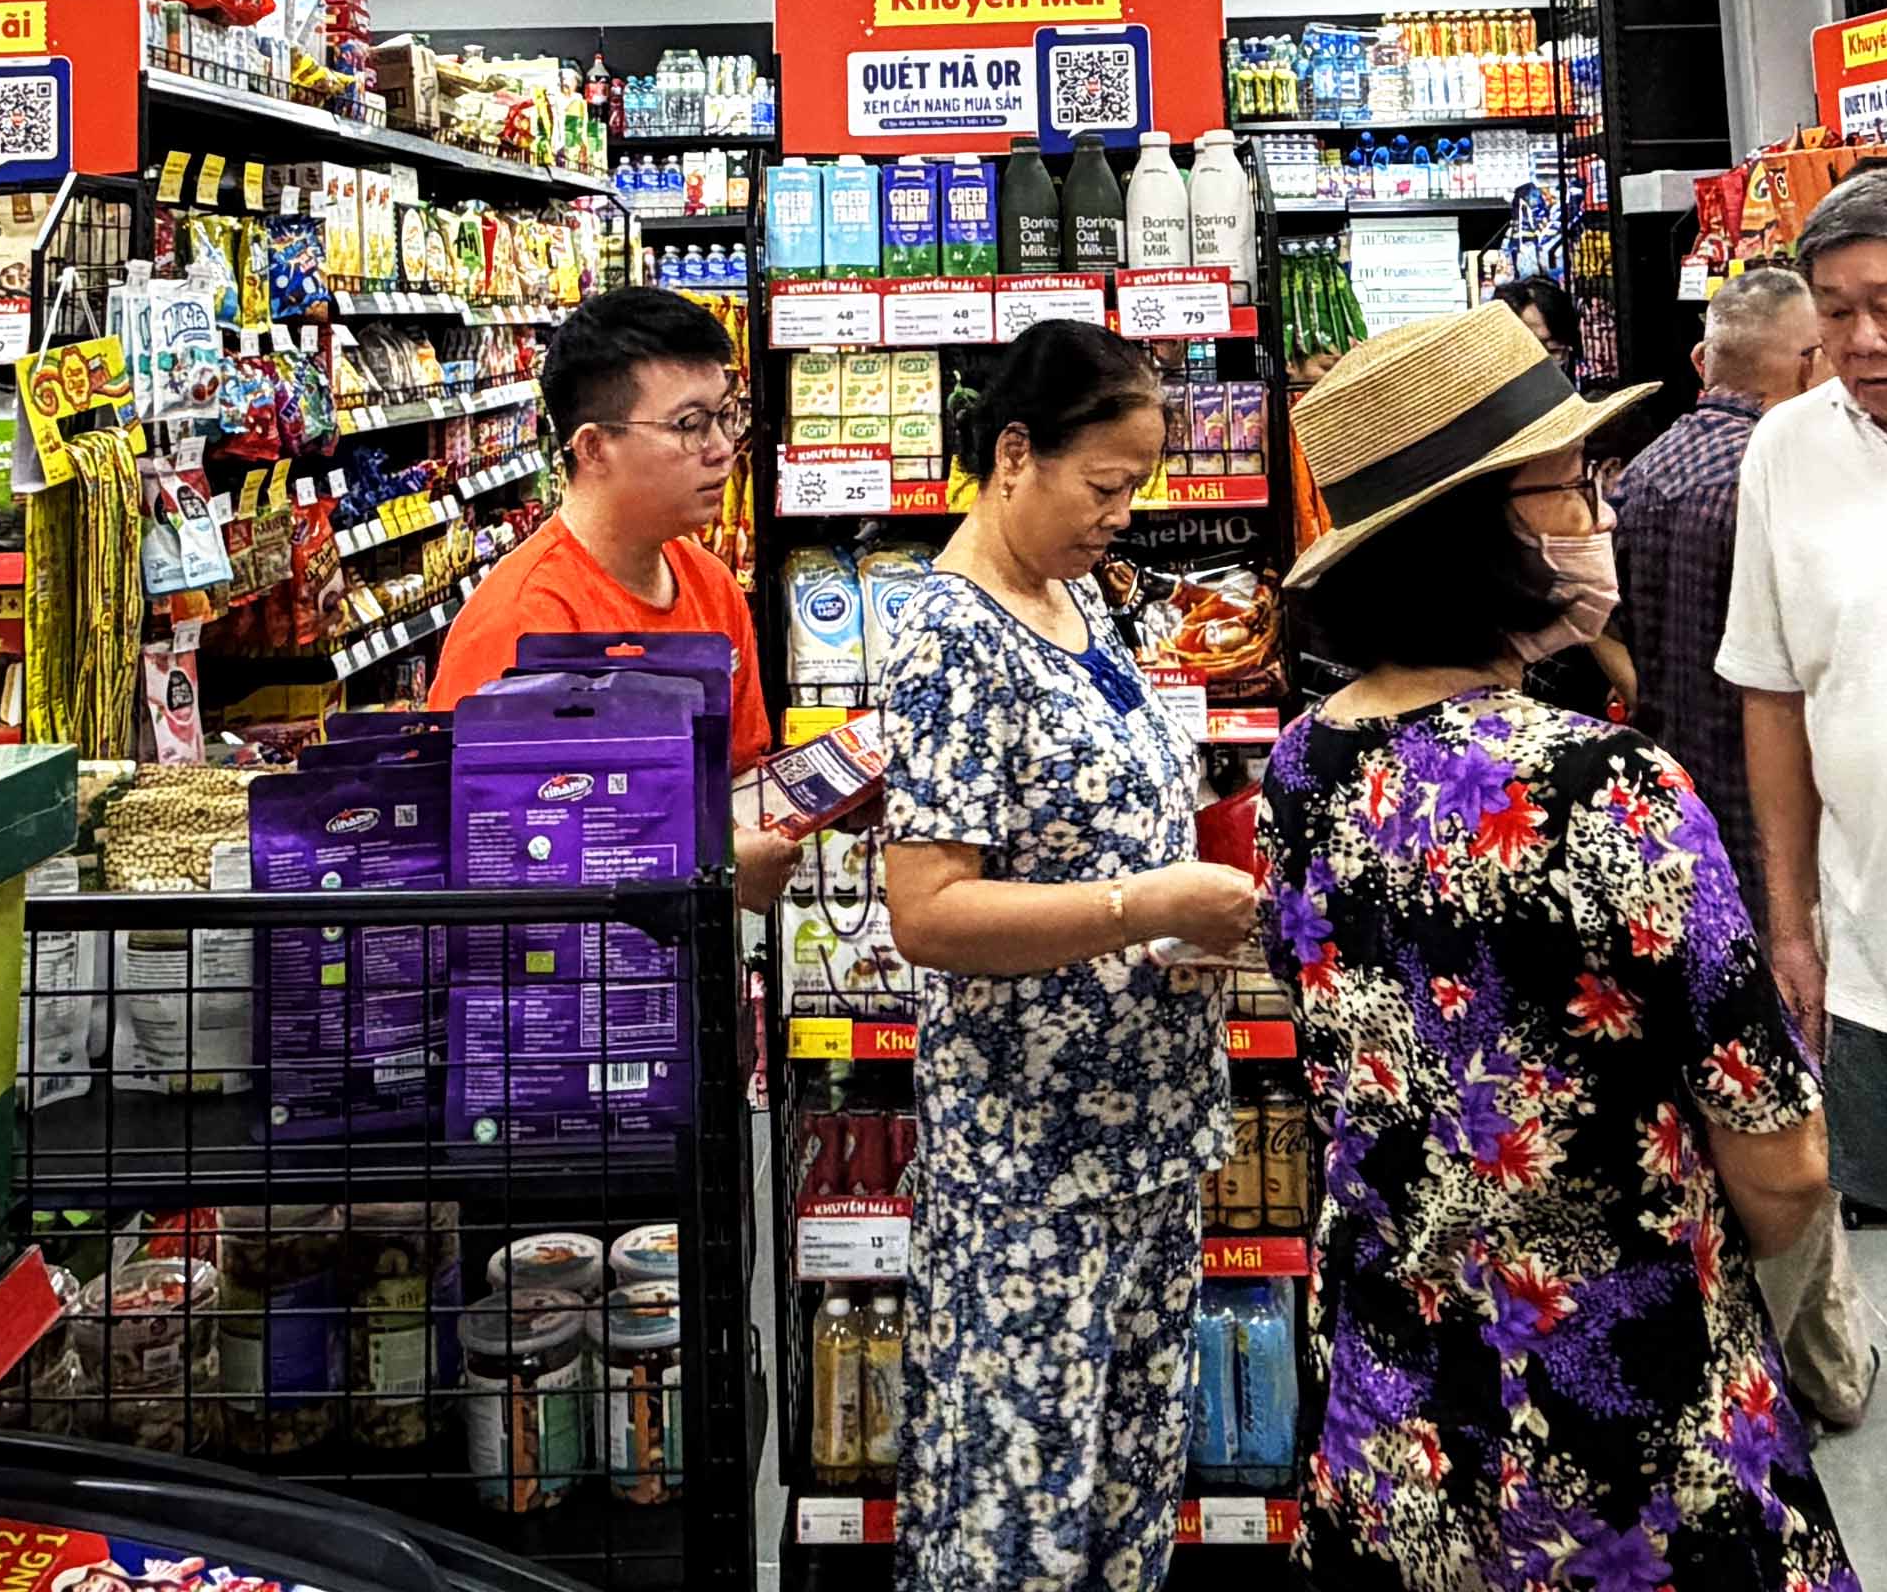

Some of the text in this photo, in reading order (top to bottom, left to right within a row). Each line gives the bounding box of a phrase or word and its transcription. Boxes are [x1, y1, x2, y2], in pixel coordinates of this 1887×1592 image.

[862, 55, 1021, 93] QUÉT MÃ QR
[863, 100, 889, 115] XEM
[925, 99, 961, 114] NANG
[965, 97, 991, 111] MUA
[889, 189, 930, 206] GREEN
[948, 187, 988, 204] GREEN
[891, 205, 928, 223] FARM
[951, 203, 987, 221] FARM
[1020, 216, 1059, 233] Boring
[1076, 216, 1116, 233] Boring
[1142, 216, 1185, 232] Boring
[1194, 214, 1236, 228] Boring
[1020, 231, 1045, 243] Oat
[1076, 230, 1100, 243] Oat
[1143, 231, 1168, 243] Oat
[1195, 229, 1216, 240] Oat
[1020, 244, 1048, 257] Milk
[1076, 244, 1103, 257] Milk
[1143, 244, 1172, 256] Milk
[1196, 242, 1219, 255] Milk
[837, 311, 854, 320] 48
[953, 309, 969, 319] 48
[1182, 311, 1205, 324] 79
[837, 328, 854, 337] 44
[953, 326, 970, 336] 44
[846, 487, 866, 499] 25
[1187, 481, 1225, 501] Mãi
[871, 1236, 883, 1248] 13
[1223, 1245, 1262, 1269] Mãi
[36, 1531, 70, 1549] 1
